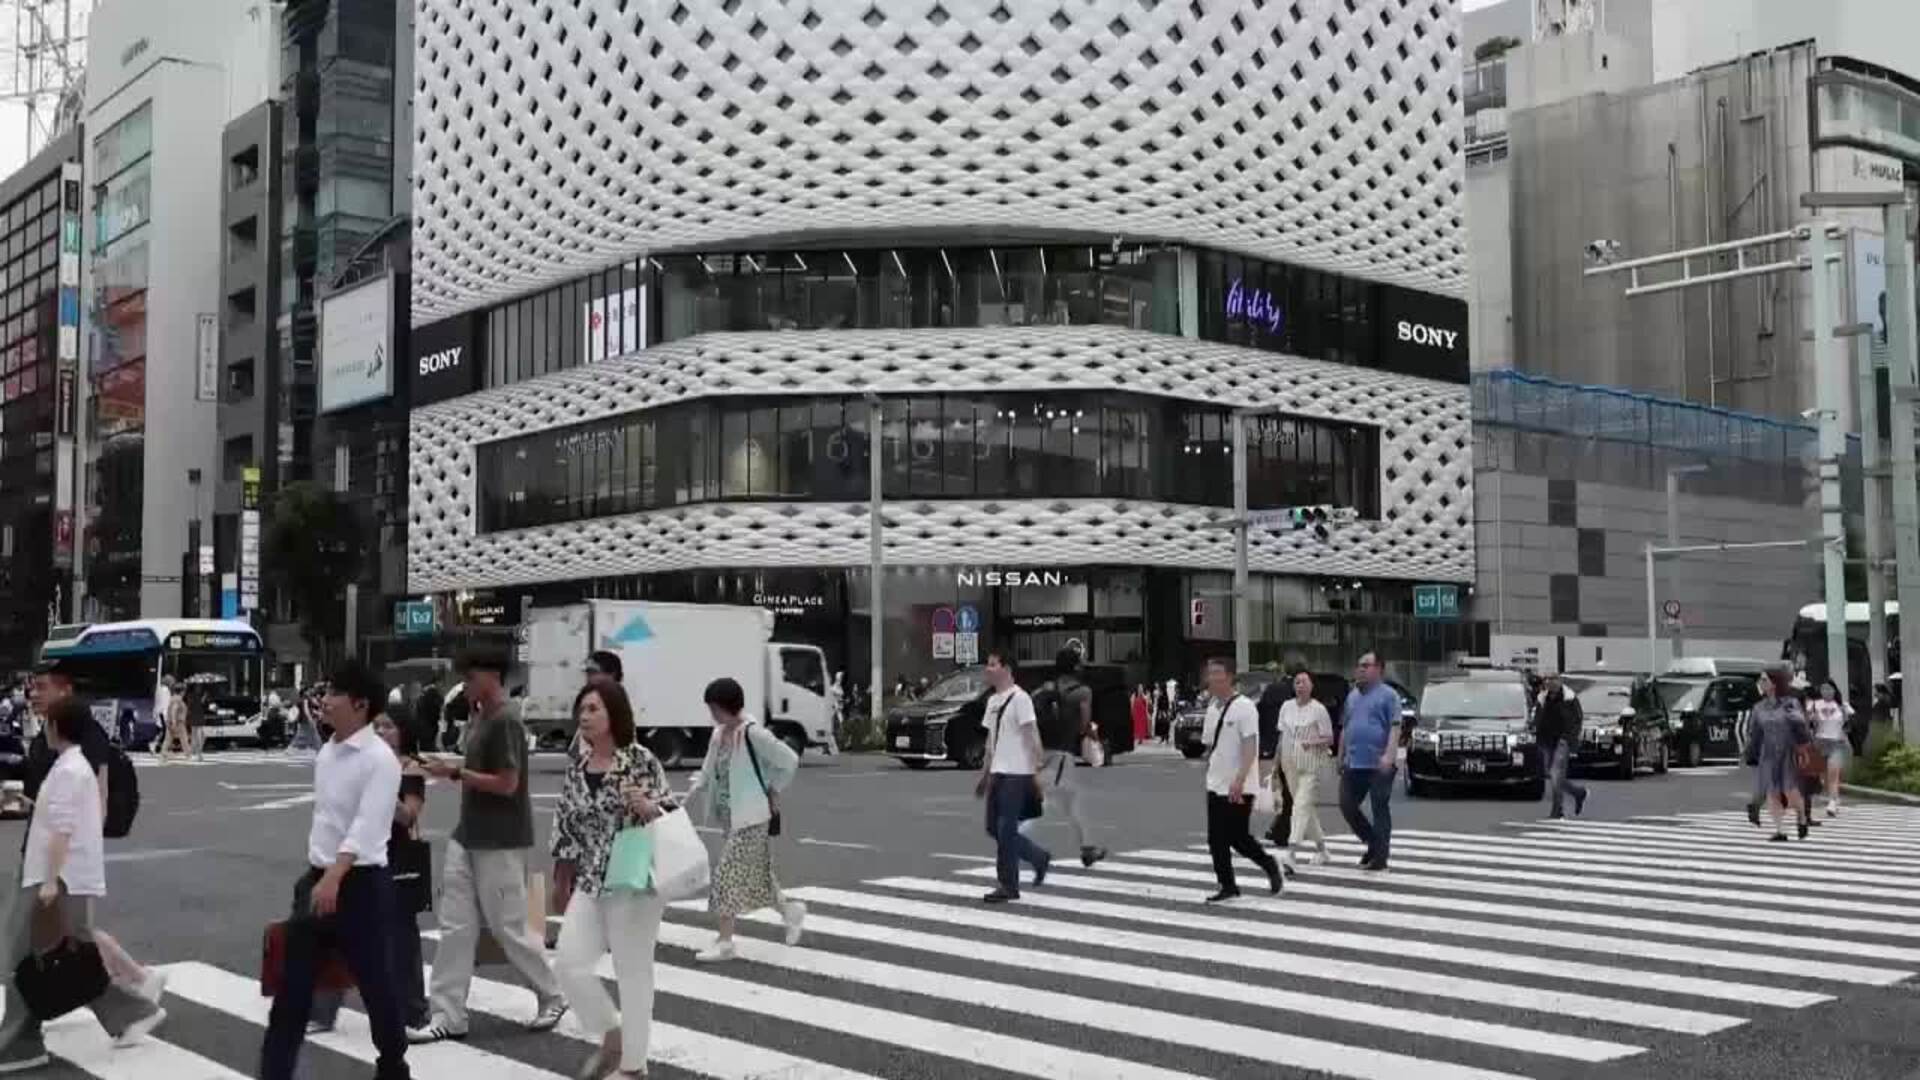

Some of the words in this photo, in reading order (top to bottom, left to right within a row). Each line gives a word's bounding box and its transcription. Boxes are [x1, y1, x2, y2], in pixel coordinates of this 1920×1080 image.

[1870, 162, 1901, 182] HULIC
[1397, 320, 1459, 350] SONY
[419, 346, 463, 376] SONY
[957, 571, 1061, 587] NISSAN
[753, 593, 788, 605] GINZA
[789, 595, 824, 606] PLACE
[1708, 726, 1729, 742] Uber
